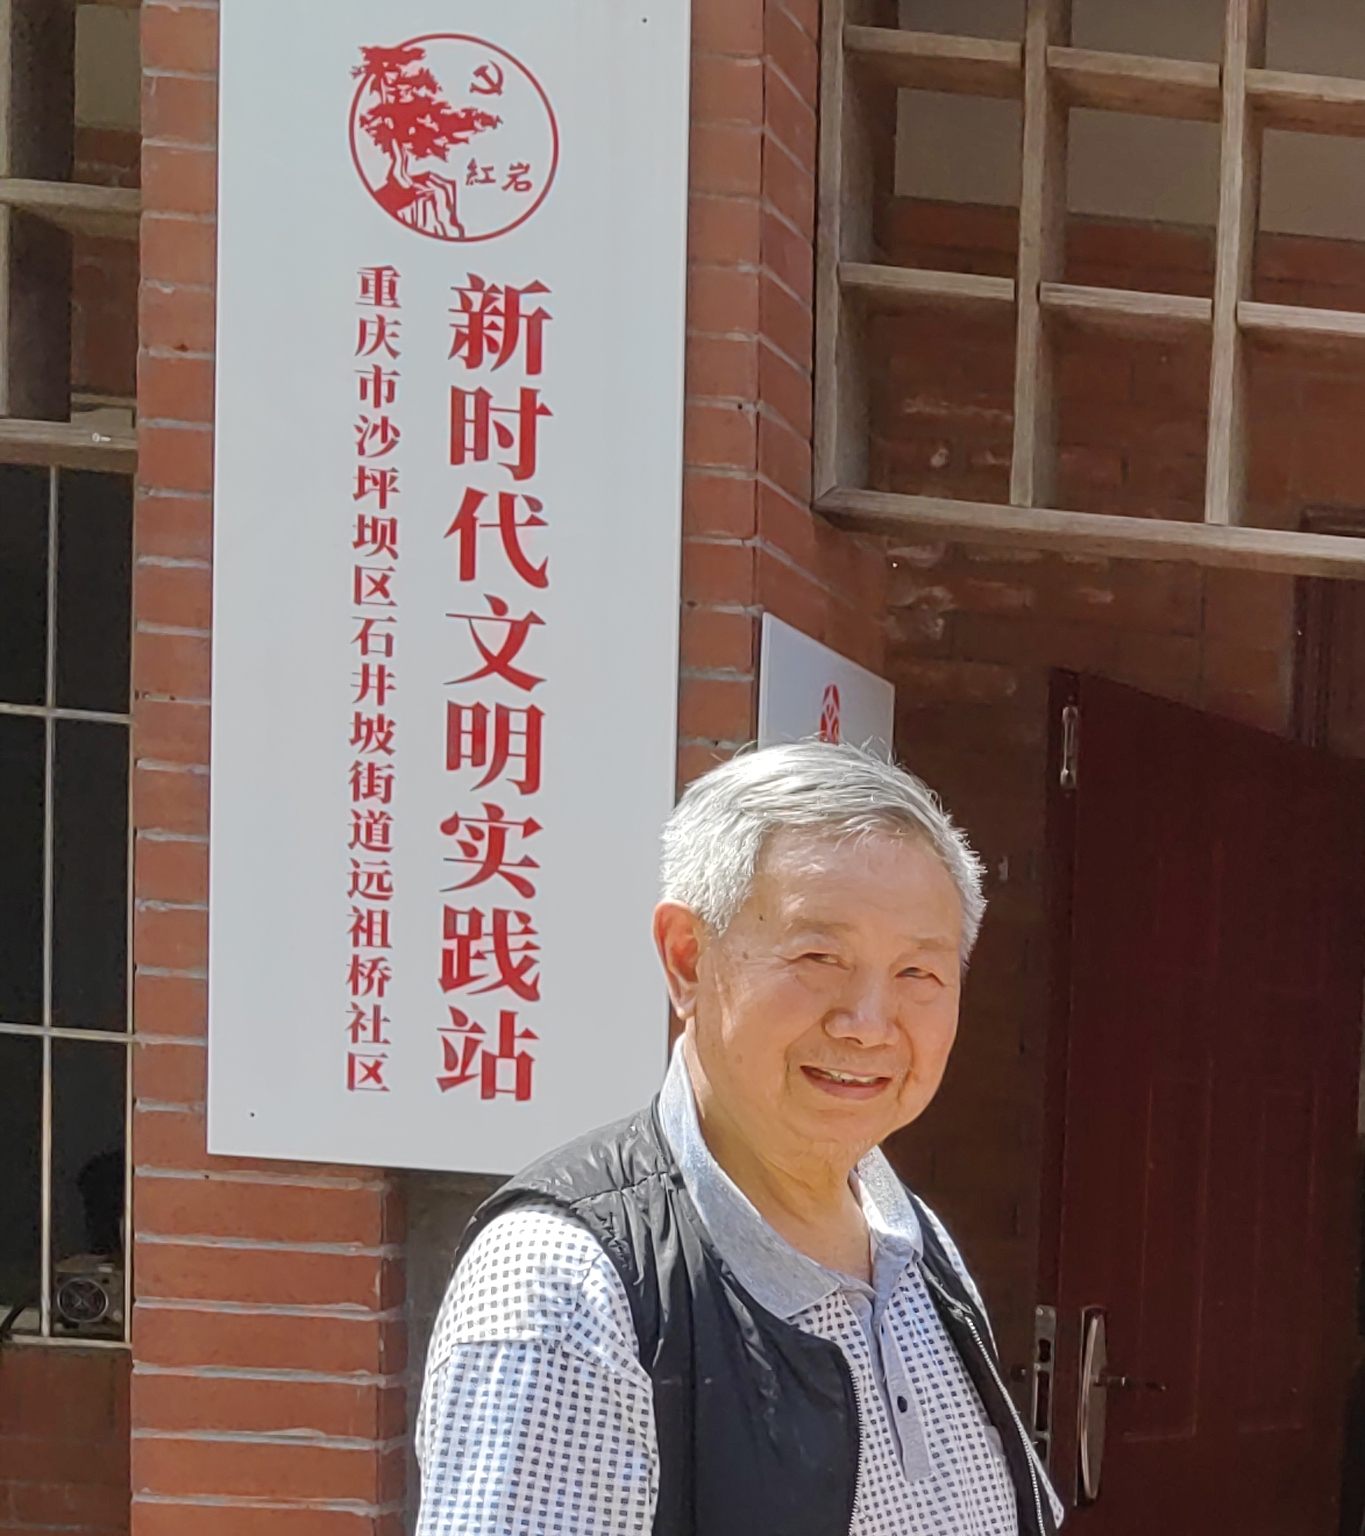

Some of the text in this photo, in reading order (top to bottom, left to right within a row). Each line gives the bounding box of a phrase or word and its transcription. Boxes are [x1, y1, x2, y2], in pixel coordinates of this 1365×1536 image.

[345, 264, 402, 1093] 重庆市沙坪坝区石井坡街道远祖桥社区
[436, 272, 554, 1102] 新时代文明实践站
